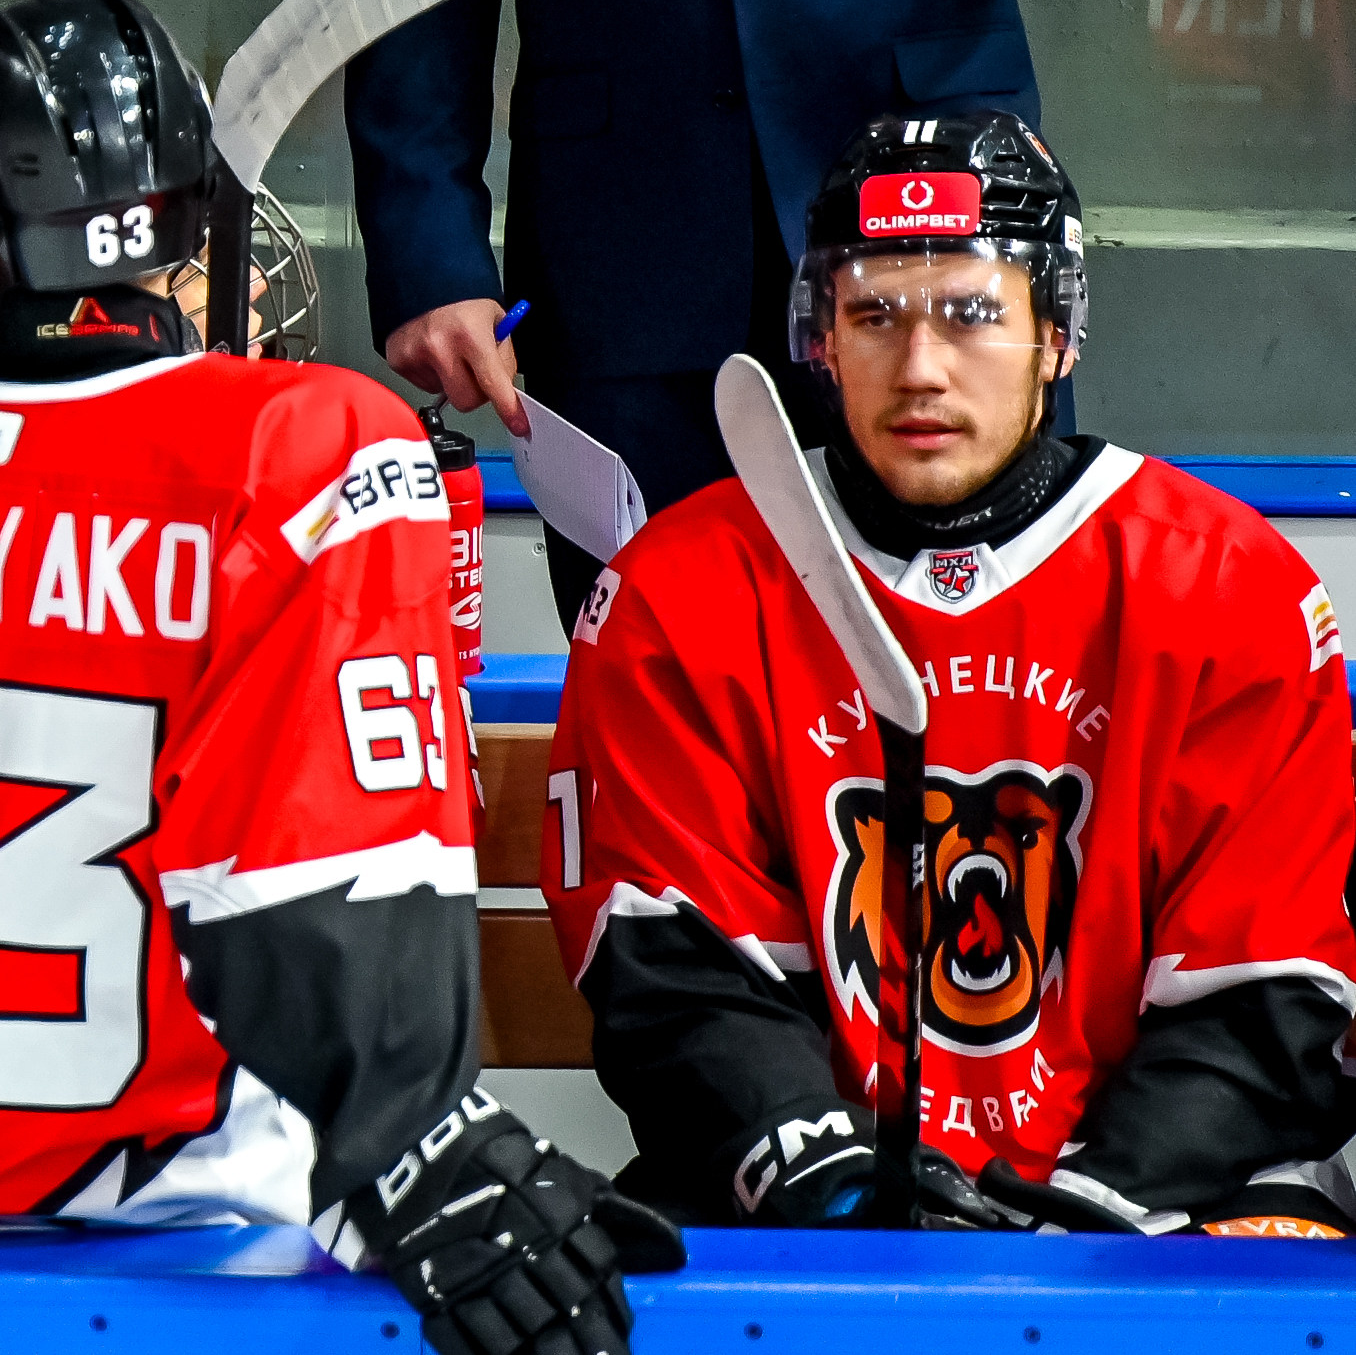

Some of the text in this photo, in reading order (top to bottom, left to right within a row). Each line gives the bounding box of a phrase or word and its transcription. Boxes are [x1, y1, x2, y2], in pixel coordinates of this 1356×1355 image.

[85, 204, 156, 268] 63
[865, 213, 970, 231] OLIMPBET
[451, 524, 483, 568] BI
[807, 654, 1112, 759] КУНЕЦКИЕ
[548, 769, 598, 889] 1
